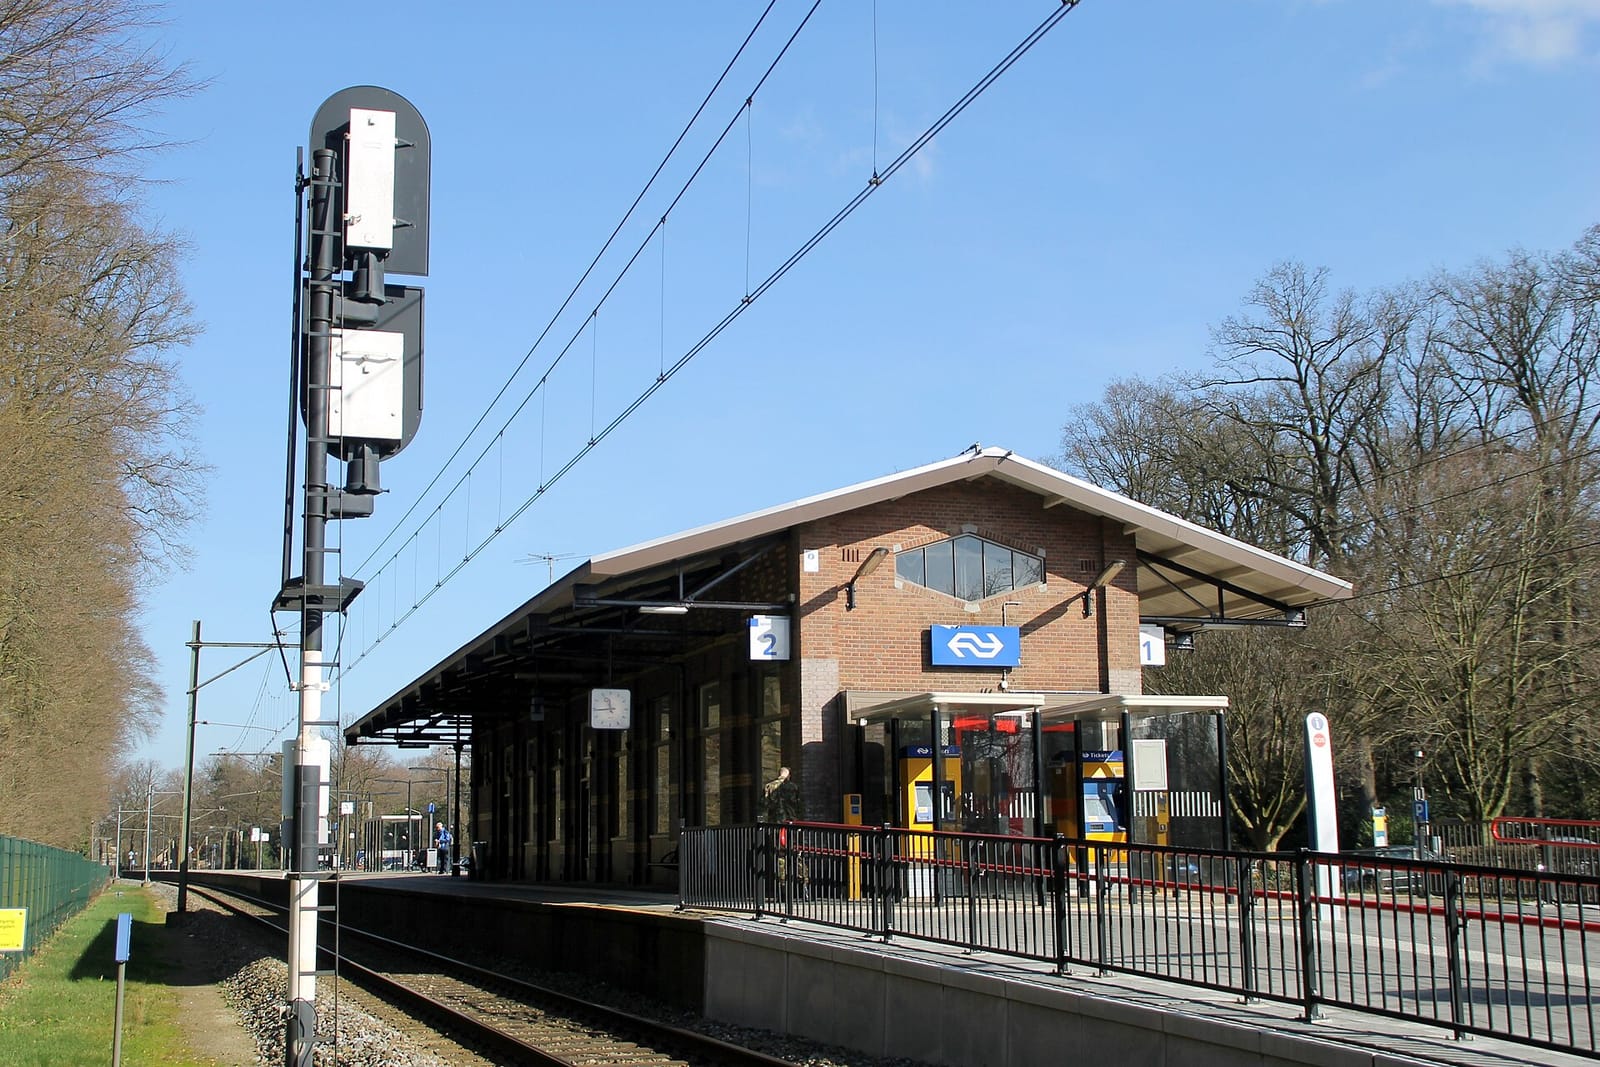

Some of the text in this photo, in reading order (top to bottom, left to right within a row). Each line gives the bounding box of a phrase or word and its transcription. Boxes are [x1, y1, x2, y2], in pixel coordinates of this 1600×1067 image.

[763, 633, 777, 656] 2
[1142, 640, 1151, 661] 1
[1415, 803, 1424, 817] P
